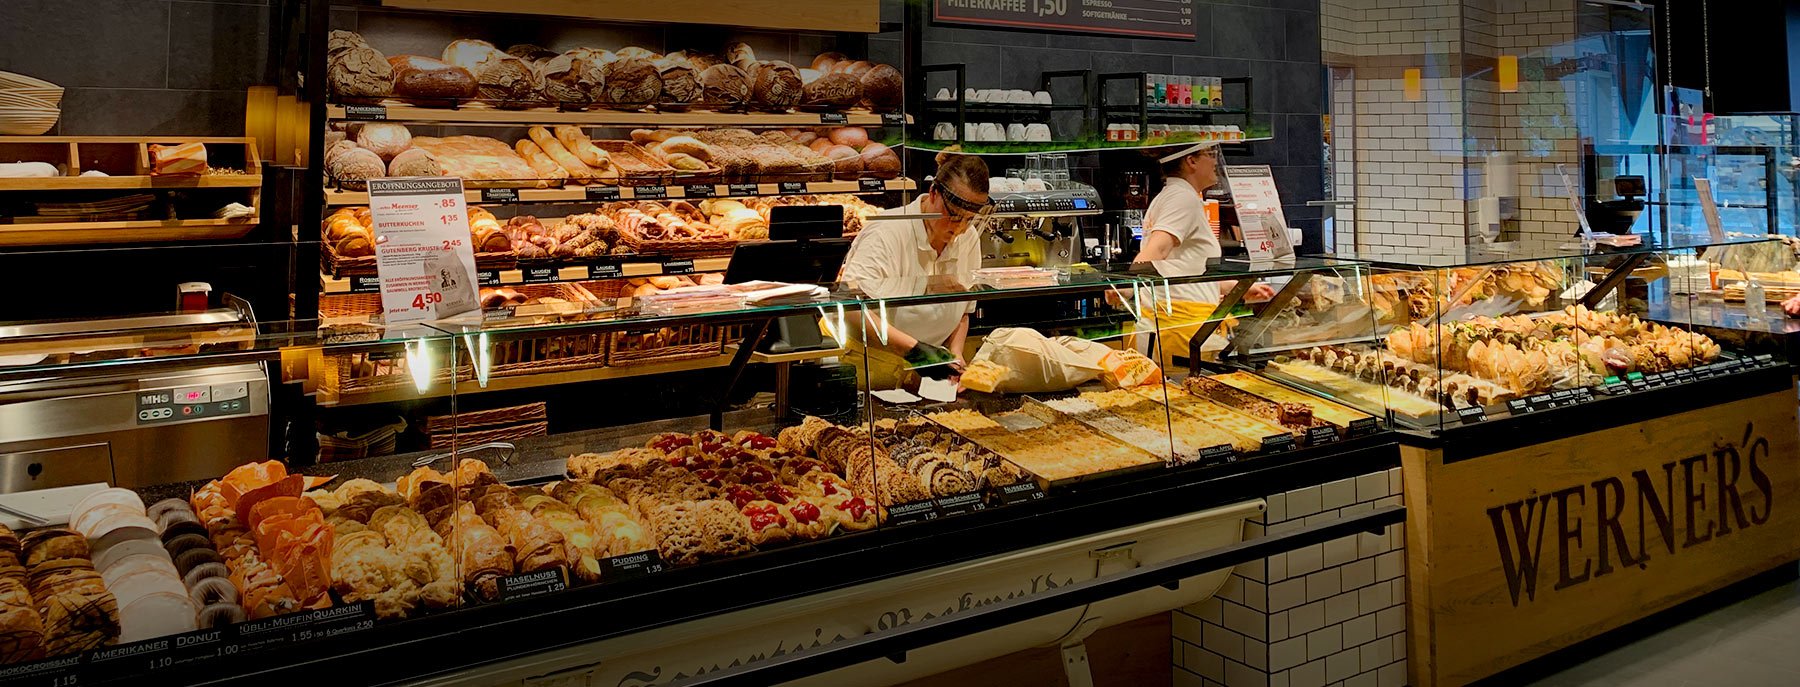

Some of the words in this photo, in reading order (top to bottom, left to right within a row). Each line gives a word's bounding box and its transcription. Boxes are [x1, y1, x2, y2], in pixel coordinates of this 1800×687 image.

[372, 181, 460, 190] ERÖFFNUNGSANGEBOTE
[142, 394, 170, 405] MHS
[612, 553, 650, 565] PUDDING
[505, 570, 558, 586] HASELNUSS
[548, 582, 566, 593] 1.25
[313, 603, 363, 620] QUARKINI
[176, 631, 222, 649] DONUT
[92, 639, 170, 662] AMERIKANER
[217, 643, 240, 657] 1.00
[150, 656, 173, 670] 1.10
